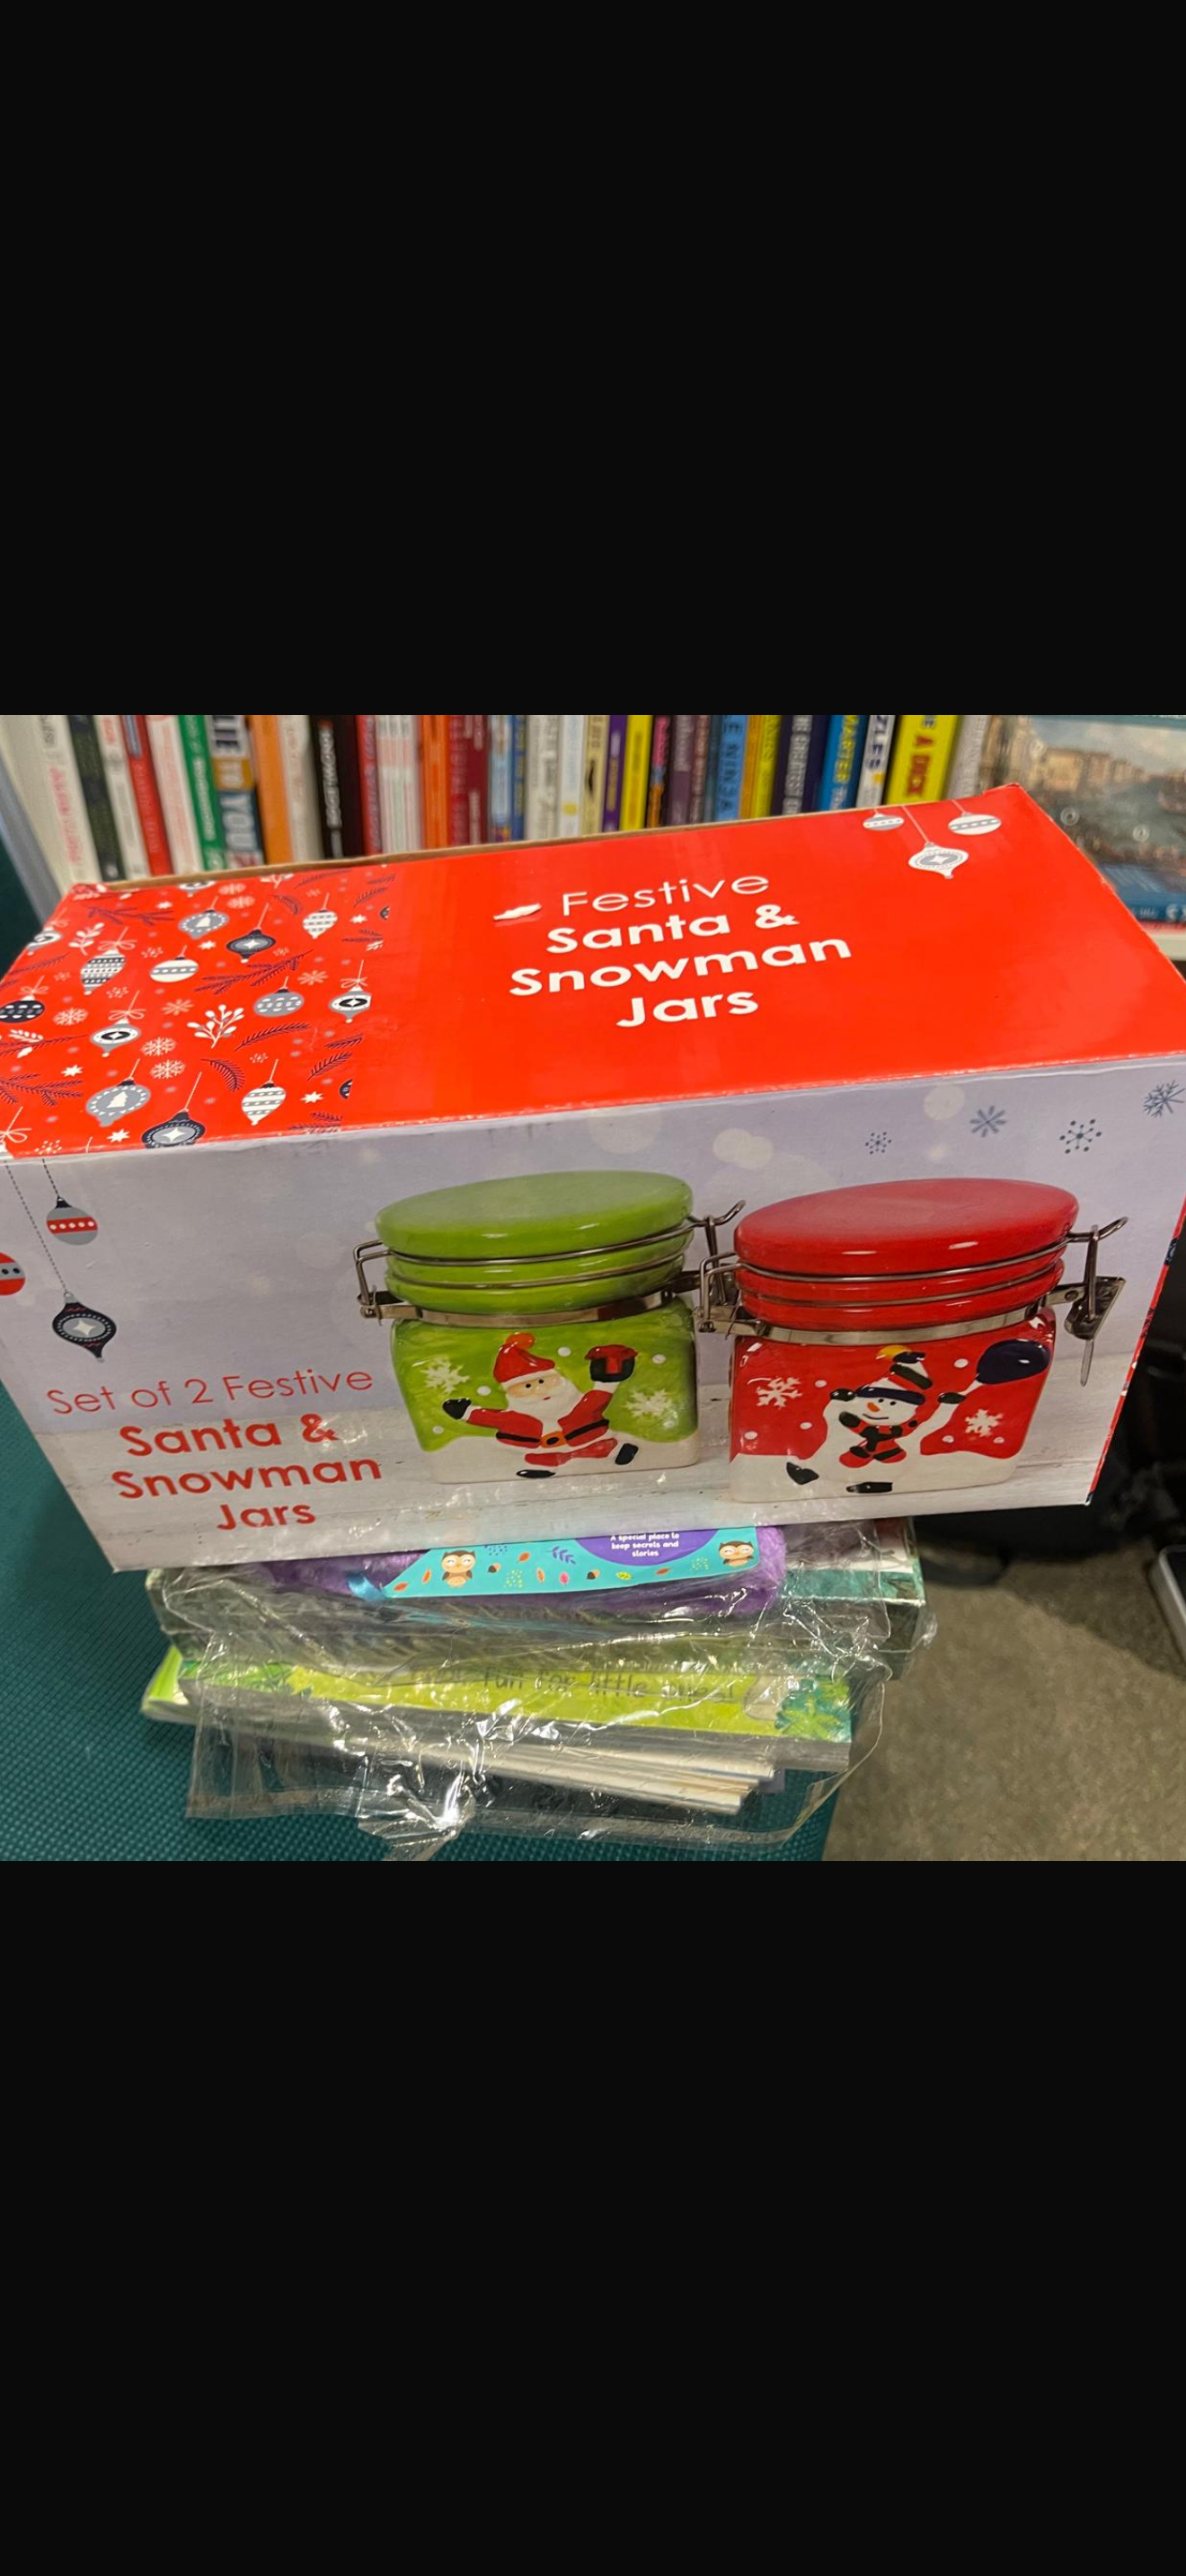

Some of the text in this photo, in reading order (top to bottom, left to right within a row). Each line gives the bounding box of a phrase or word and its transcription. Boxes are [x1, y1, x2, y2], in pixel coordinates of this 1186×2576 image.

[915, 736, 934, 747] A
[221, 762, 244, 788] TO
[319, 728, 342, 828] KNOWLEDGE
[718, 743, 739, 812] NINJA
[784, 734, 811, 797] GREATEST
[905, 754, 932, 798] DICK
[220, 792, 255, 850] YOU
[562, 876, 769, 916] Festive
[546, 904, 800, 954] Santa &
[509, 939, 852, 996] Snowman
[615, 992, 758, 1028] Jars
[46, 1368, 373, 1415] Set of 2 Festive
[119, 1413, 339, 1457] Santa &
[111, 1458, 382, 1499] Snowman
[216, 1504, 316, 1531] Jars
[618, 1533, 646, 1542] special
[648, 1532, 670, 1541] place
[671, 1531, 680, 1539] to
[611, 1539, 679, 1551] keep secrets and
[632, 1549, 659, 1557] stories
[482, 1663, 525, 1690] fun
[589, 1665, 649, 1698] little
